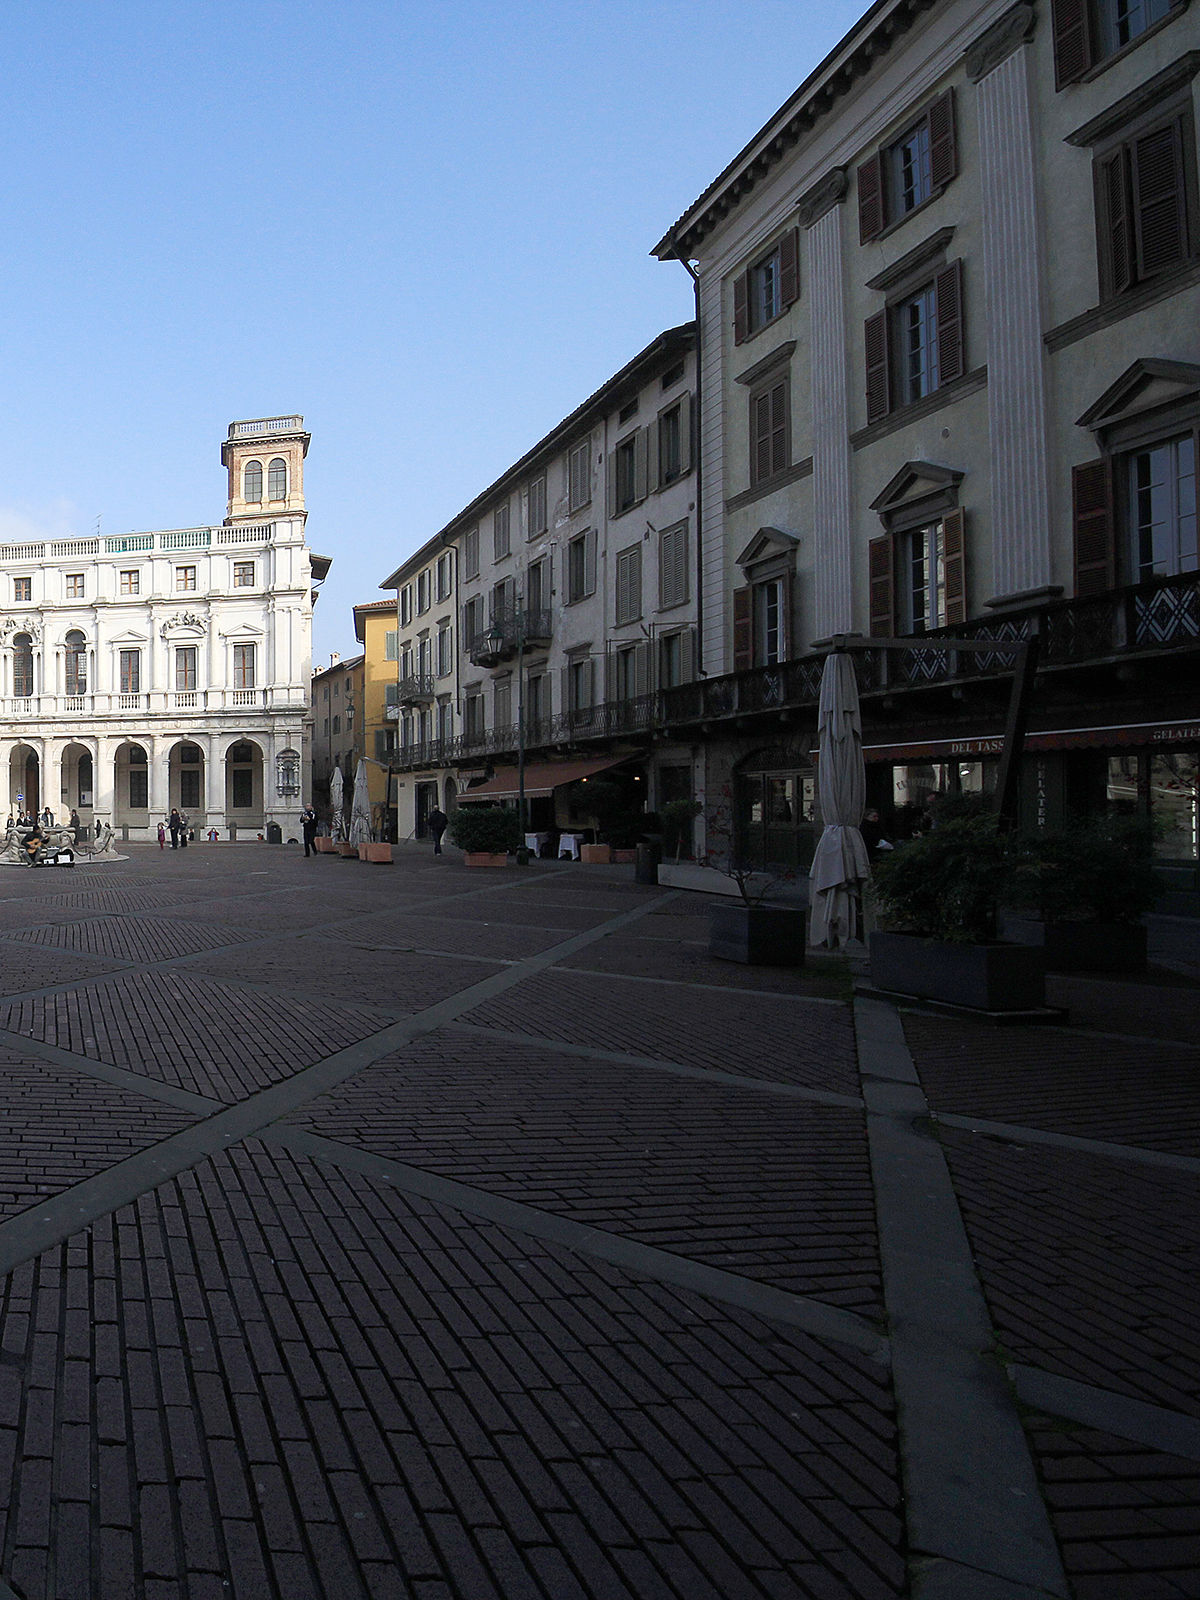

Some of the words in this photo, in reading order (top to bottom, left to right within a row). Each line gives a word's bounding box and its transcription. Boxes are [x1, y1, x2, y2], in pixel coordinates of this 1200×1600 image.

[1152, 726, 1200, 740] GELATE
[951, 742, 972, 753] DEL
[977, 739, 1005, 752] TASS
